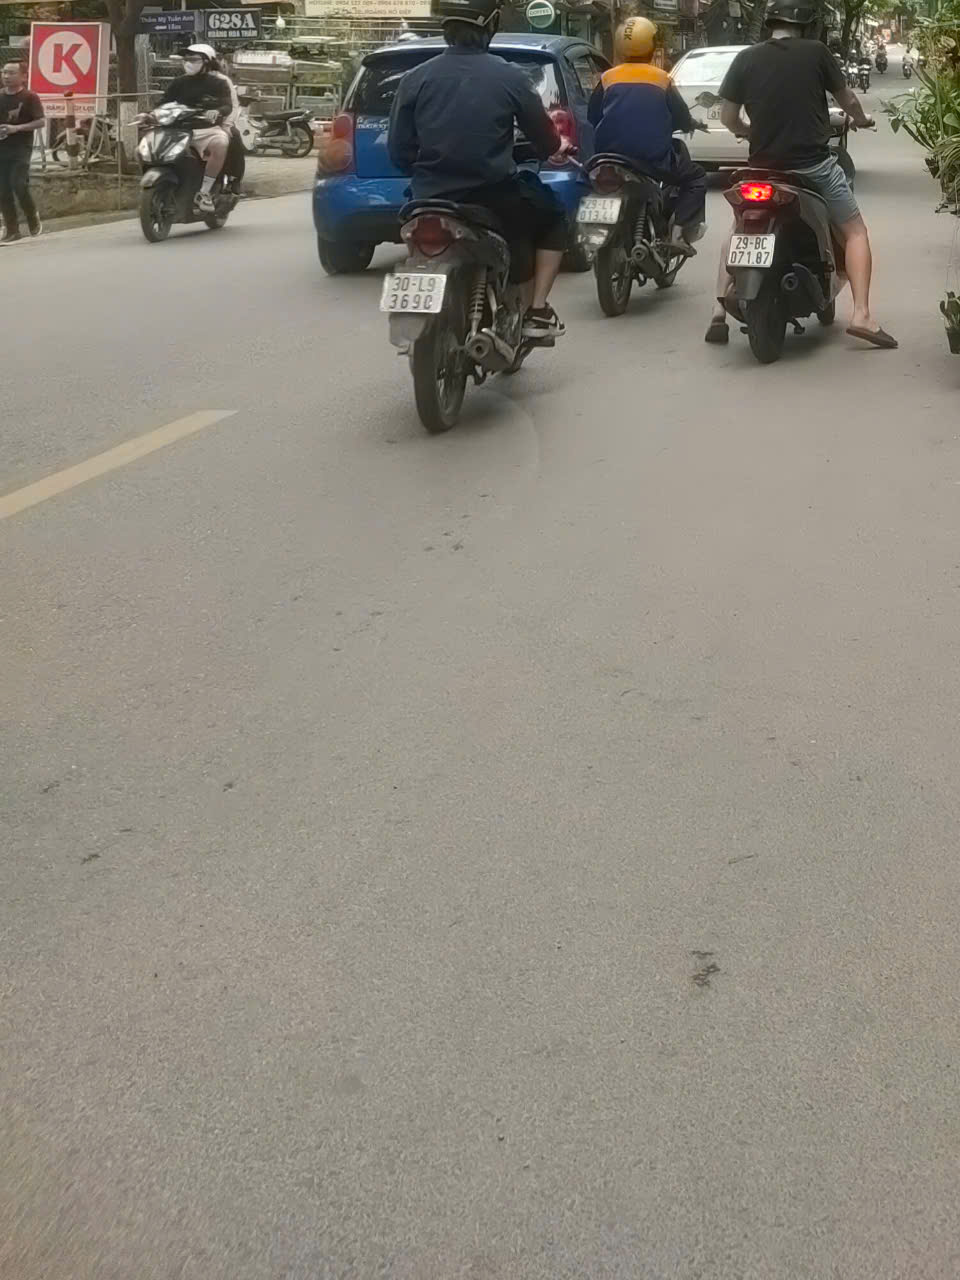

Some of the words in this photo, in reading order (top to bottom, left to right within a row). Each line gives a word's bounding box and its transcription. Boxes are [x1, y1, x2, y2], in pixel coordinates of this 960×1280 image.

[208, 13, 256, 29] 628A
[735, 236, 768, 250] 29-BC
[730, 251, 770, 265] 071.87
[392, 276, 436, 292] 30-L9
